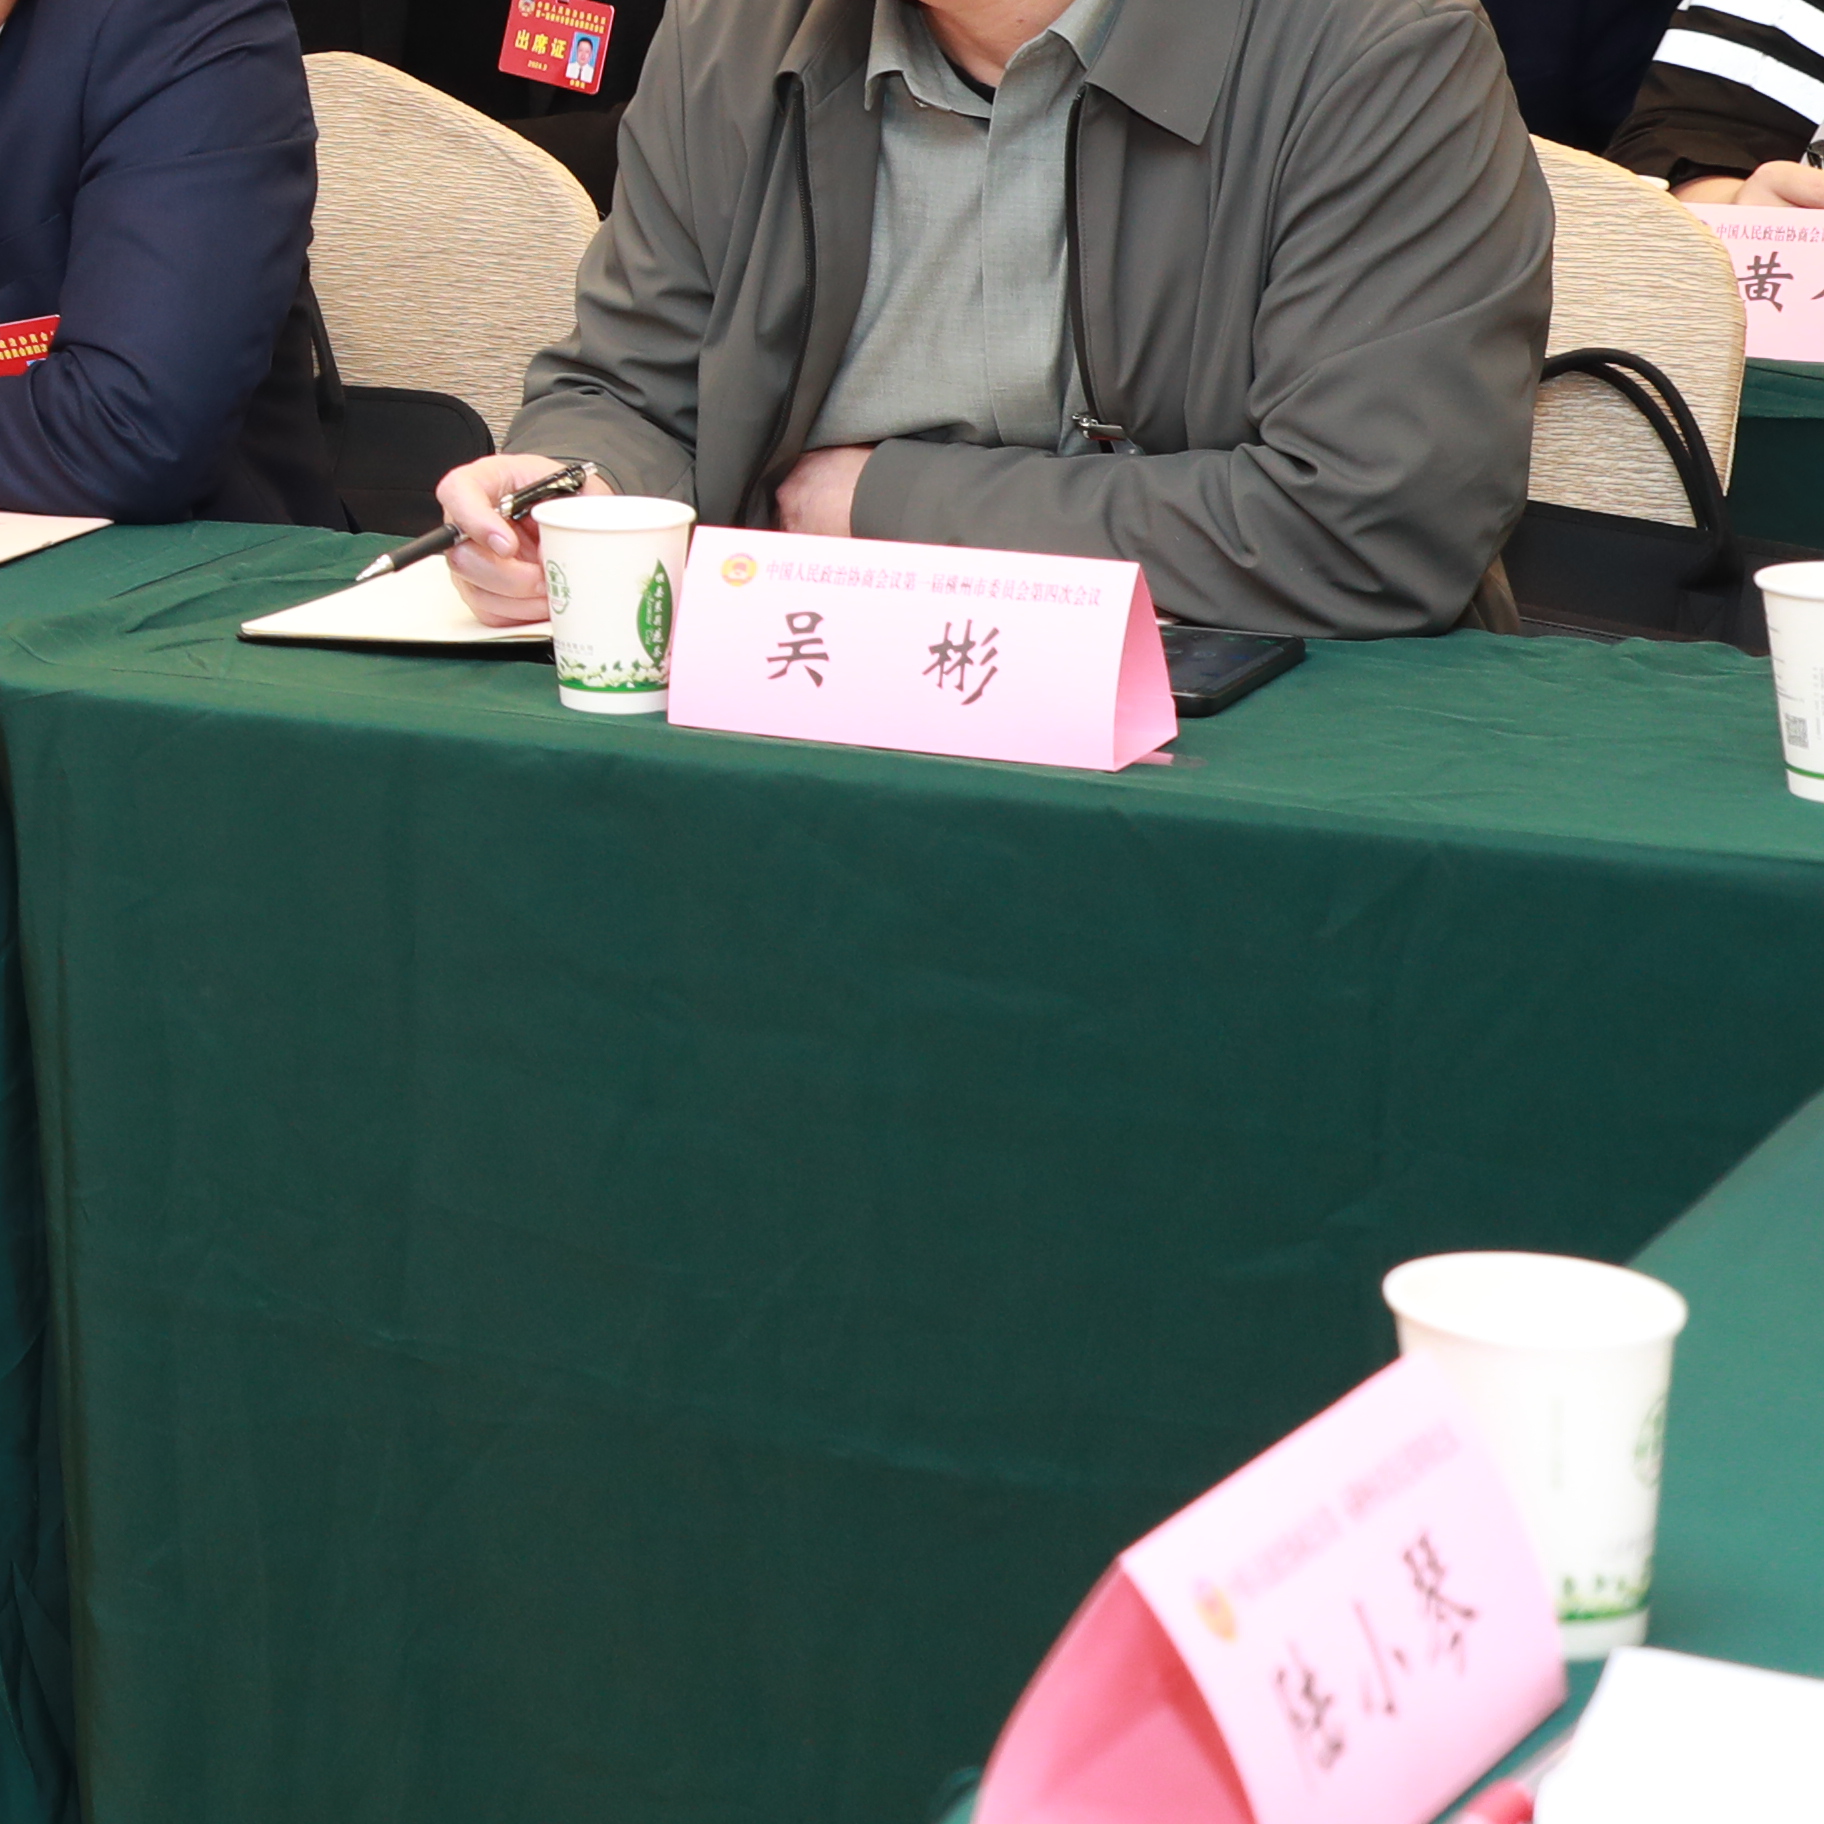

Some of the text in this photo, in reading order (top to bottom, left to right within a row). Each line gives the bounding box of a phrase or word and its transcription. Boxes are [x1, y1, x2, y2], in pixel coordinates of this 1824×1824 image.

[515, 29, 567, 59] 出席证
[1716, 223, 1824, 243] 中国人民政治协商会
[1738, 251, 1824, 312] 黄
[766, 611, 999, 706] 吴彬
